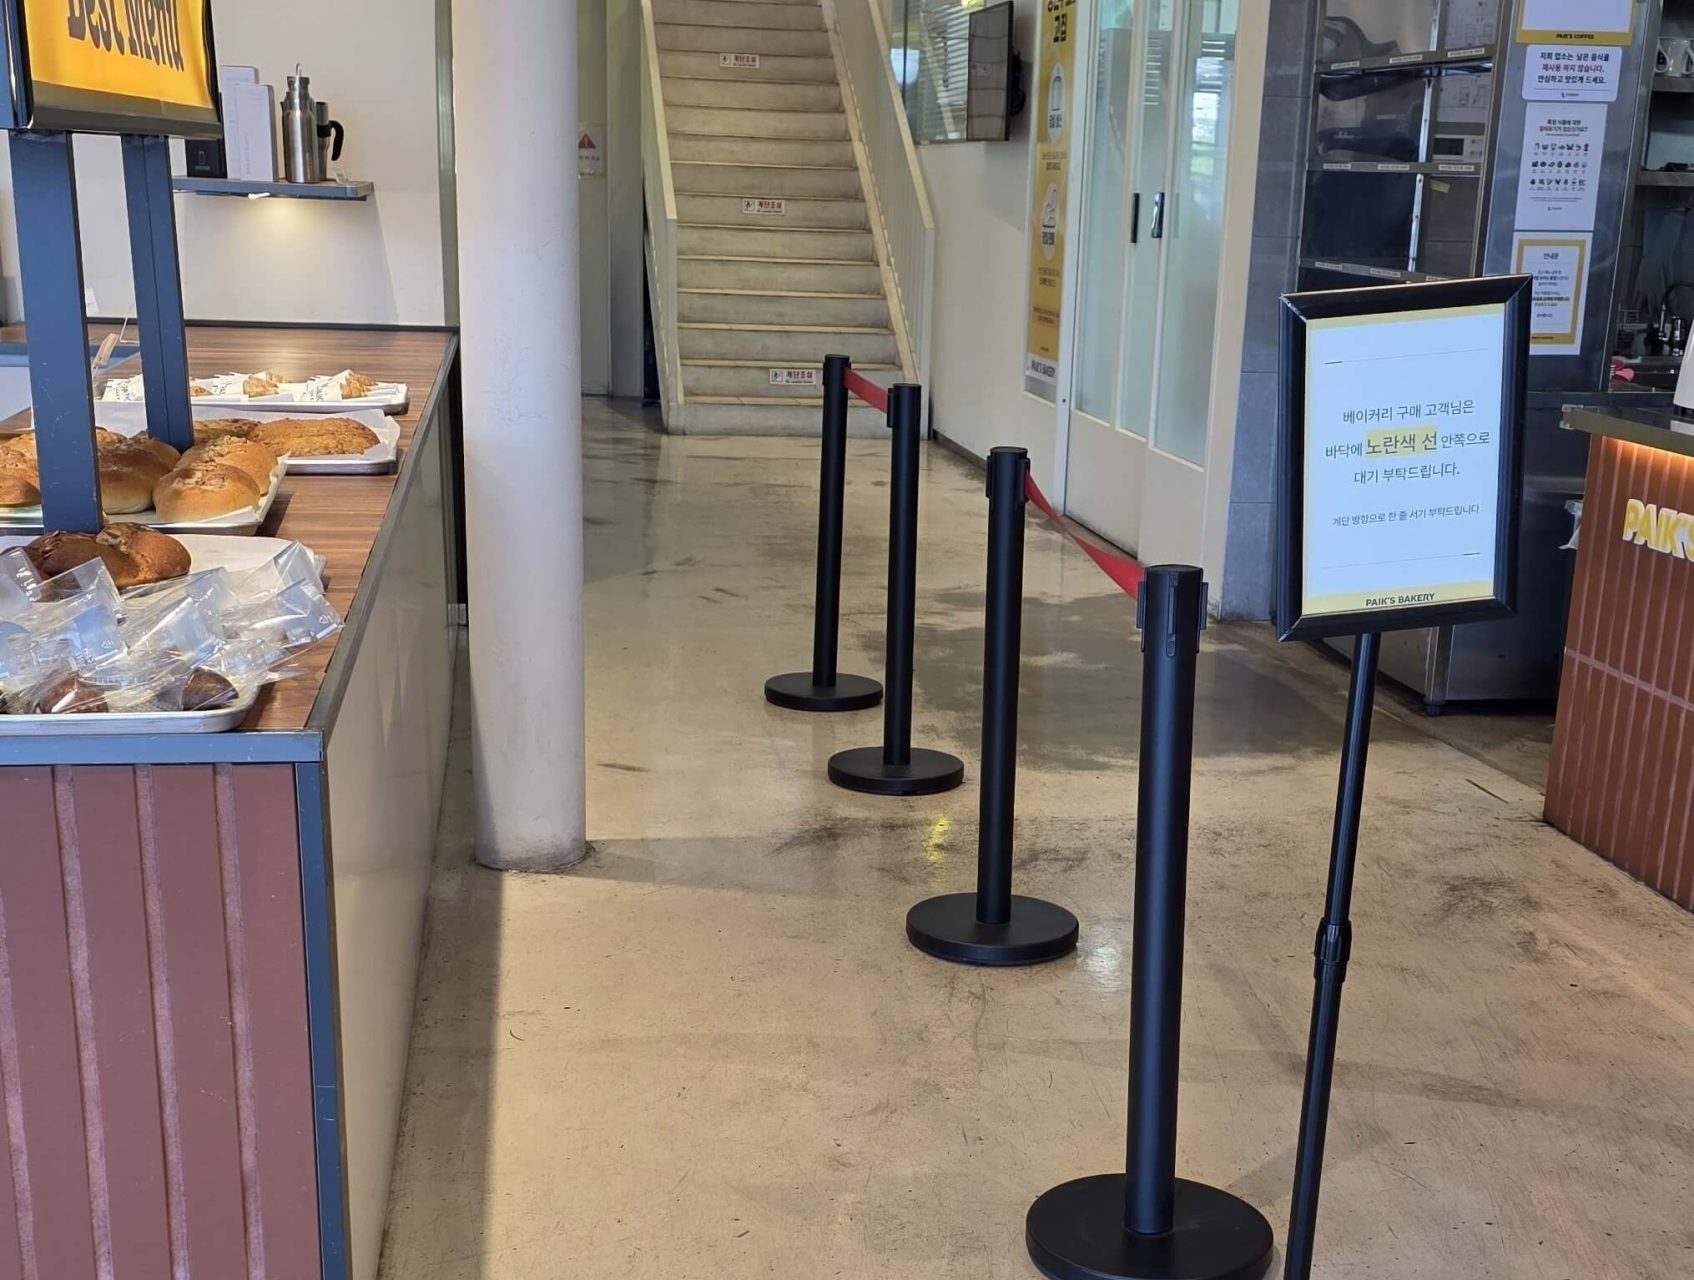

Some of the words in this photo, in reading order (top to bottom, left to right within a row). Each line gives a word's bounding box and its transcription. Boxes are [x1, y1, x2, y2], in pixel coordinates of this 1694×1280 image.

[1343, 407, 1393, 424] 베이커리
[1396, 404, 1421, 420] 구매
[1425, 400, 1475, 418] 고객님은
[1325, 442, 1363, 459] 바닥에
[1366, 433, 1416, 455] 노란색
[1421, 432, 1438, 451] 선
[1441, 431, 1490, 448] 안쪽으로
[1354, 469, 1379, 484] 대기
[1383, 462, 1460, 481] 부탁드립니다.
[1333, 516, 1350, 527] 계단
[1351, 513, 1387, 526] 방향으로
[1388, 512, 1397, 522] 한
[1398, 510, 1408, 521] 줄
[1409, 509, 1427, 520] 서기
[1428, 503, 1480, 517] 부탁드립니다
[1365, 596, 1396, 607] PAIK'S
[1397, 593, 1436, 604] BAKERY
